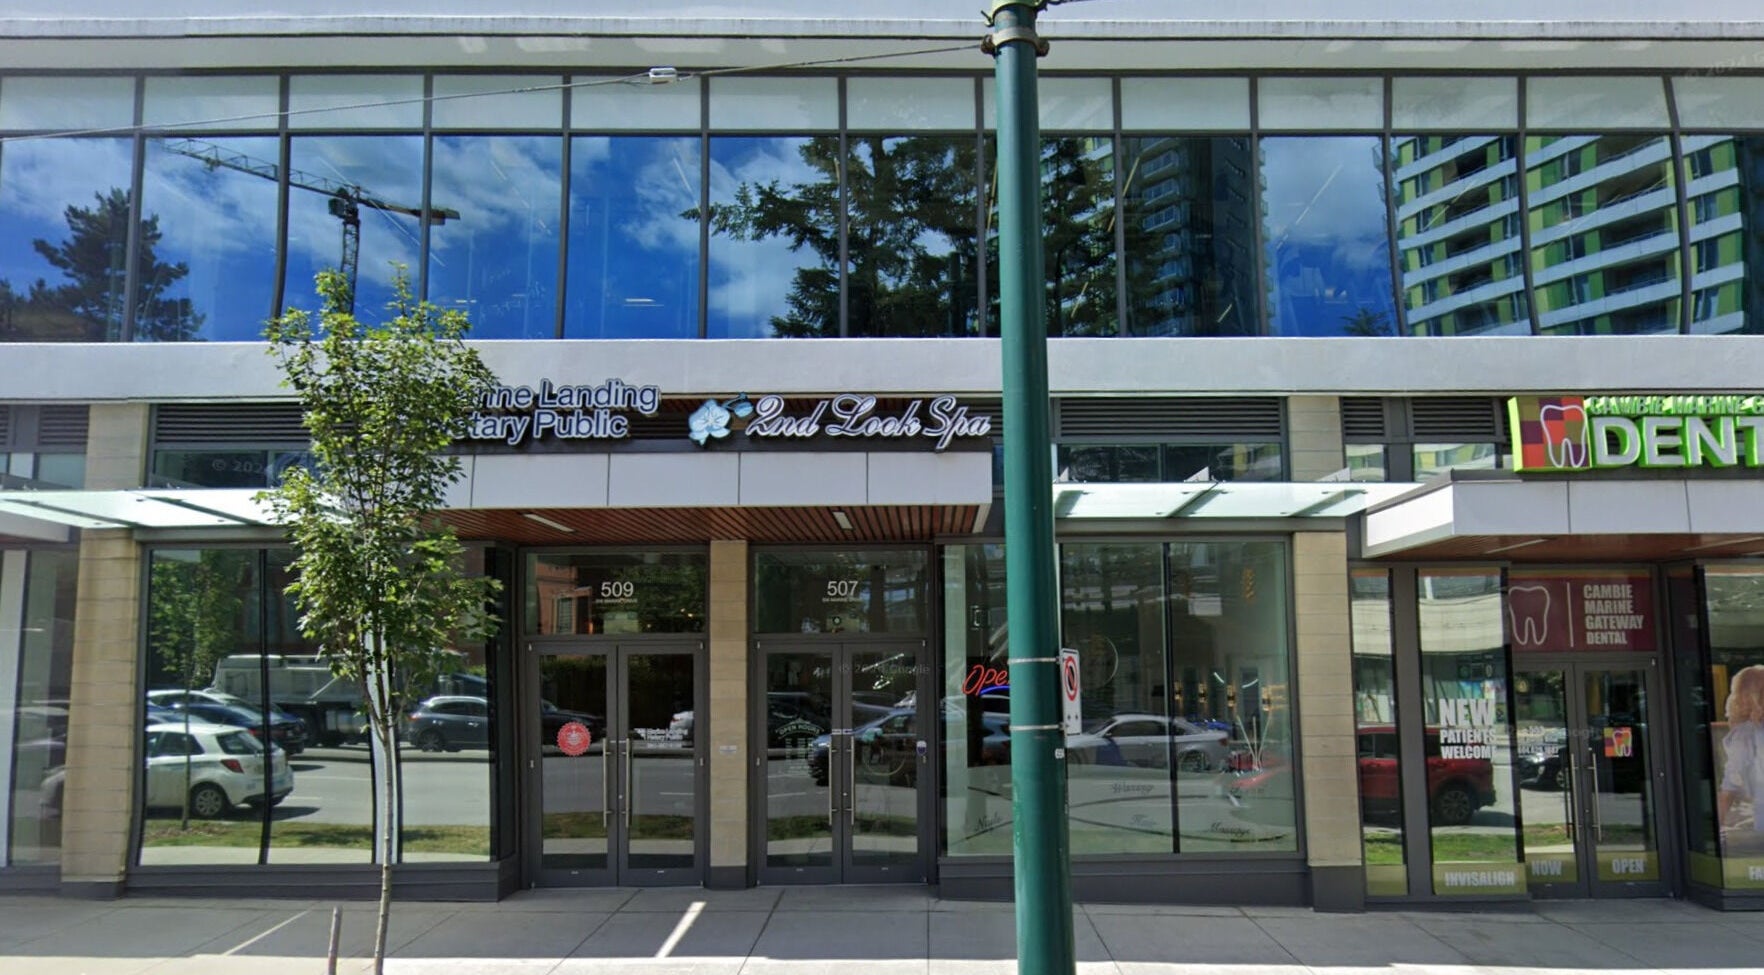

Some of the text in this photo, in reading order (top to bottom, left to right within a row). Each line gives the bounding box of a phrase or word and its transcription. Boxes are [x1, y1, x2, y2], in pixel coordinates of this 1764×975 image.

[539, 378, 661, 415] Landing
[1588, 396, 1664, 415] CAMBIE
[1671, 396, 1746, 415] MARINE
[533, 409, 629, 439] Public
[745, 393, 992, 450] 2nd Look Spa
[600, 581, 635, 598] 509
[827, 580, 859, 597] 507
[1583, 584, 1634, 599] CAMBIE
[1584, 600, 1634, 615] MARINE
[1585, 615, 1645, 630] GATEWAY
[1586, 631, 1628, 645] DENTAL
[962, 664, 1010, 696] Ope
[1439, 698, 1496, 728] NEW
[1440, 728, 1497, 745] PATIENTS
[1531, 858, 1645, 876] NOW OPEN
[1444, 870, 1516, 888] INVISALIGN
